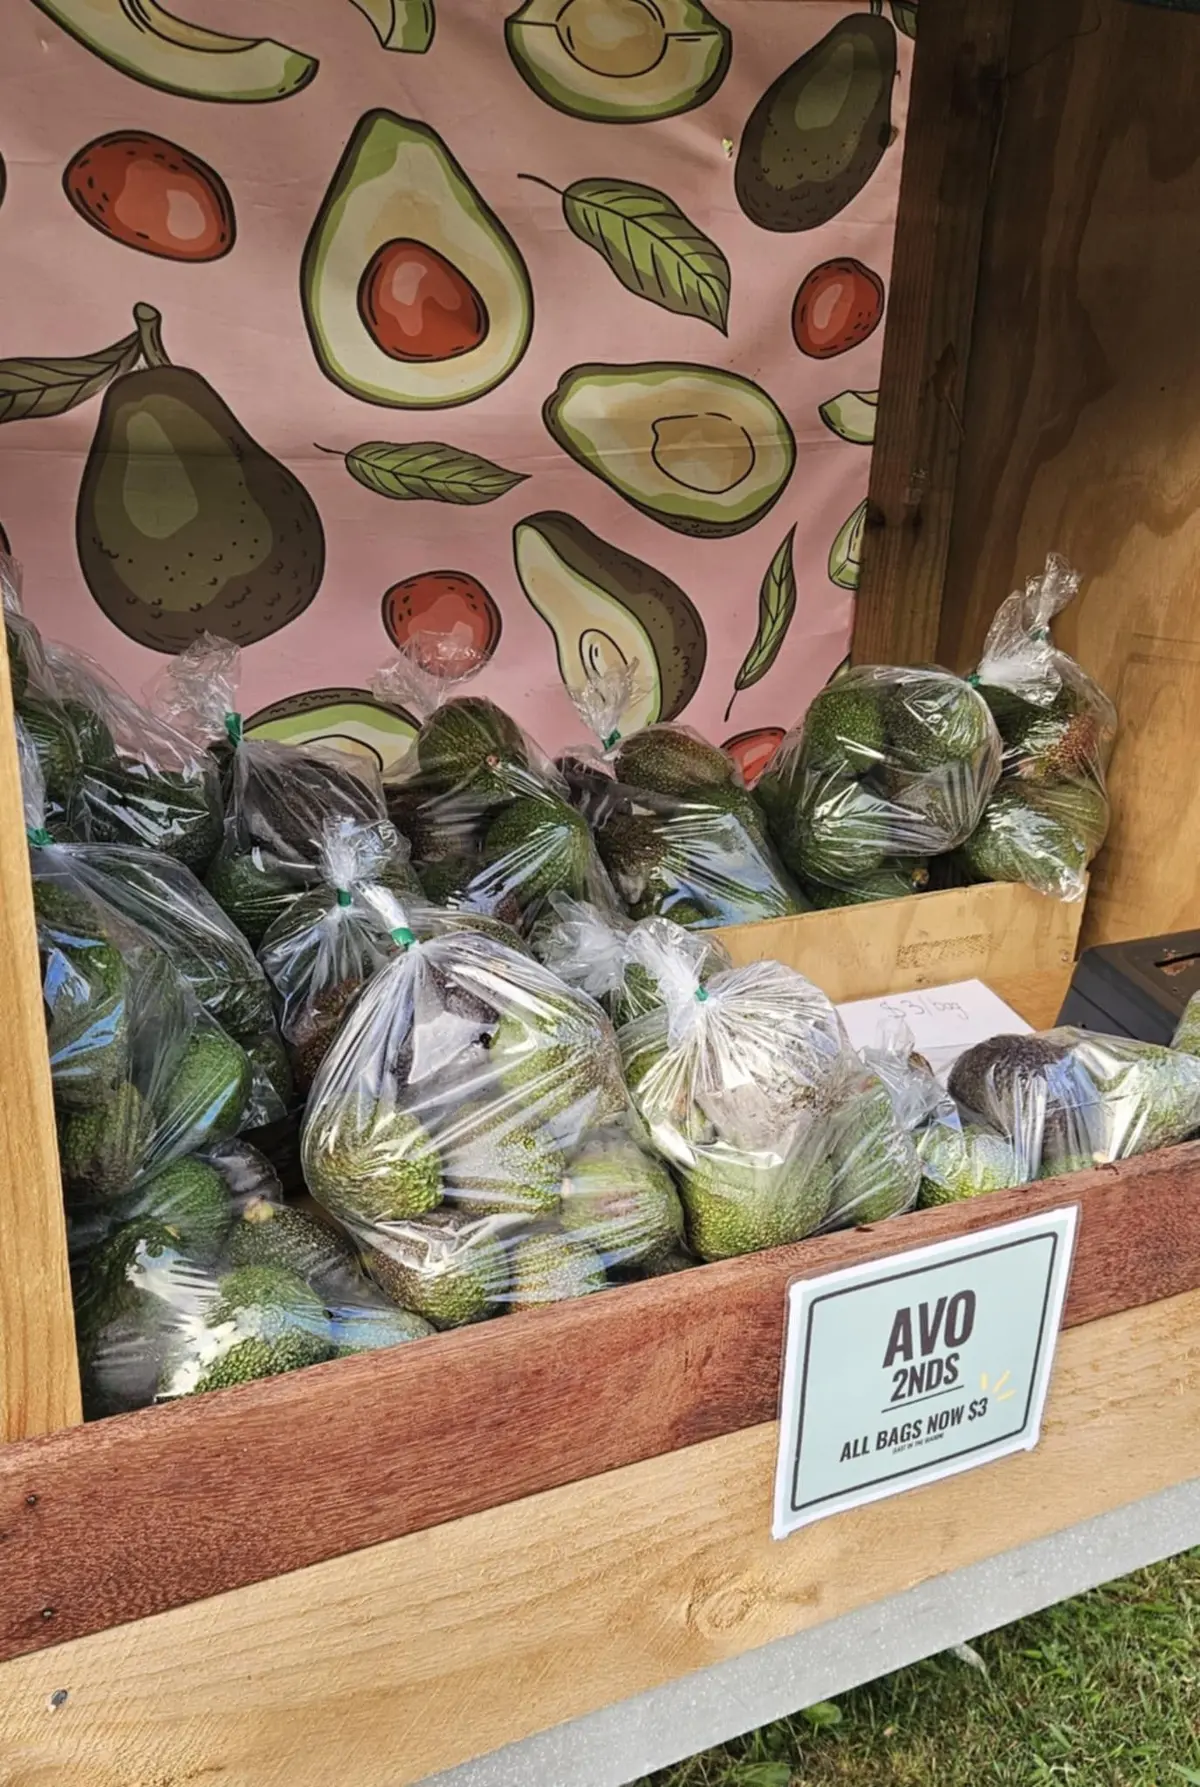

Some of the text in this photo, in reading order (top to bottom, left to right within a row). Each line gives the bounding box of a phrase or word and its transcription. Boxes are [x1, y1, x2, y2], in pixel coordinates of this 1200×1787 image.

[882, 1289, 977, 1369] AVO
[890, 1352, 960, 1403] 2NDS
[839, 1435, 871, 1462] ALL
[875, 1418, 922, 1451] BAGS
[926, 1404, 965, 1435] NOW
[967, 1396, 989, 1421] $3
